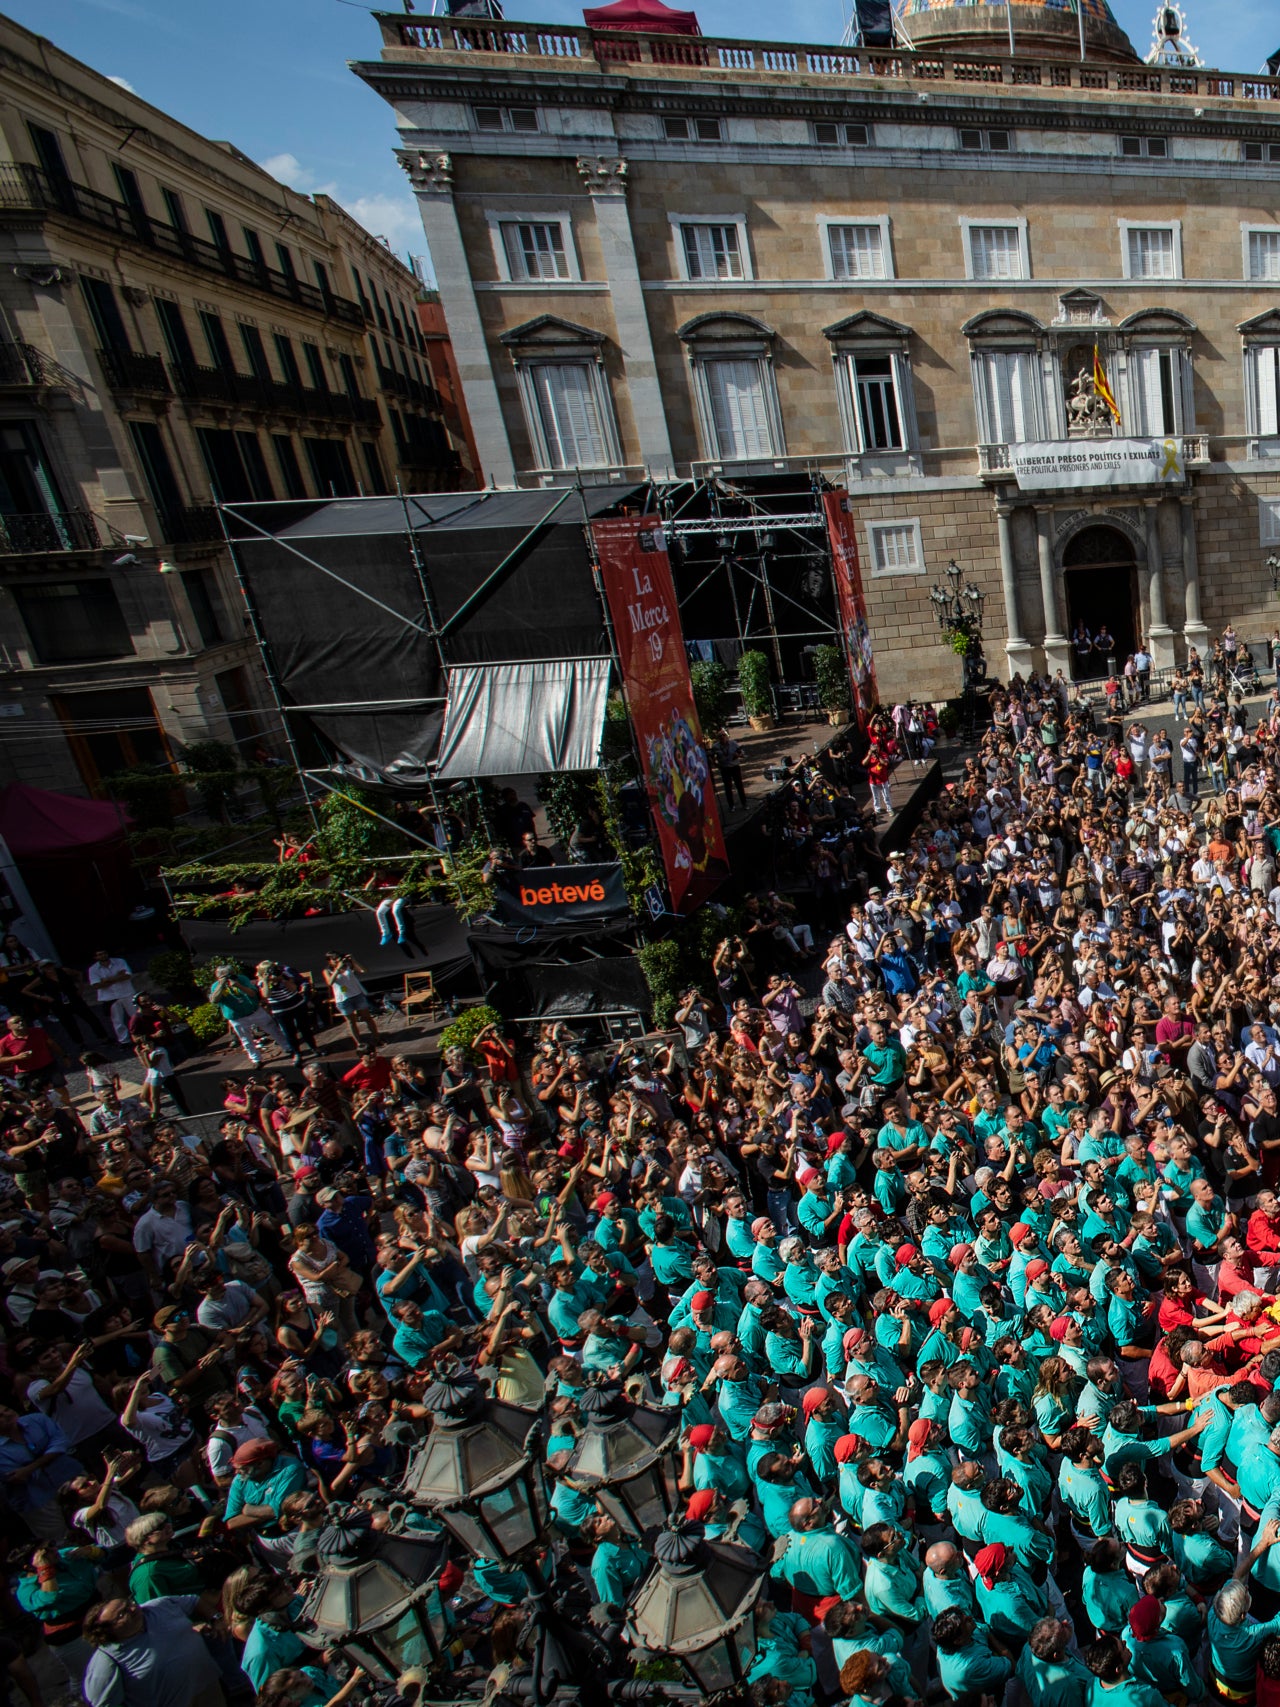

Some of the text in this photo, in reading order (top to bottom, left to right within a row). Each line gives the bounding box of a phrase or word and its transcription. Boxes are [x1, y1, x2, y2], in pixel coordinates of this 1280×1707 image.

[1015, 456, 1055, 466] LLIBERTAT
[1057, 453, 1086, 463] PRESOS
[1089, 451, 1121, 461] POLÍTICS
[1129, 451, 1160, 460] EXILIATS
[1016, 461, 1121, 475] FREE POLITICAL PRISONERS AND EXILES
[632, 567, 653, 595] La
[628, 596, 669, 634] Mercè
[648, 631, 663, 662] 19
[520, 879, 606, 906] betevé
